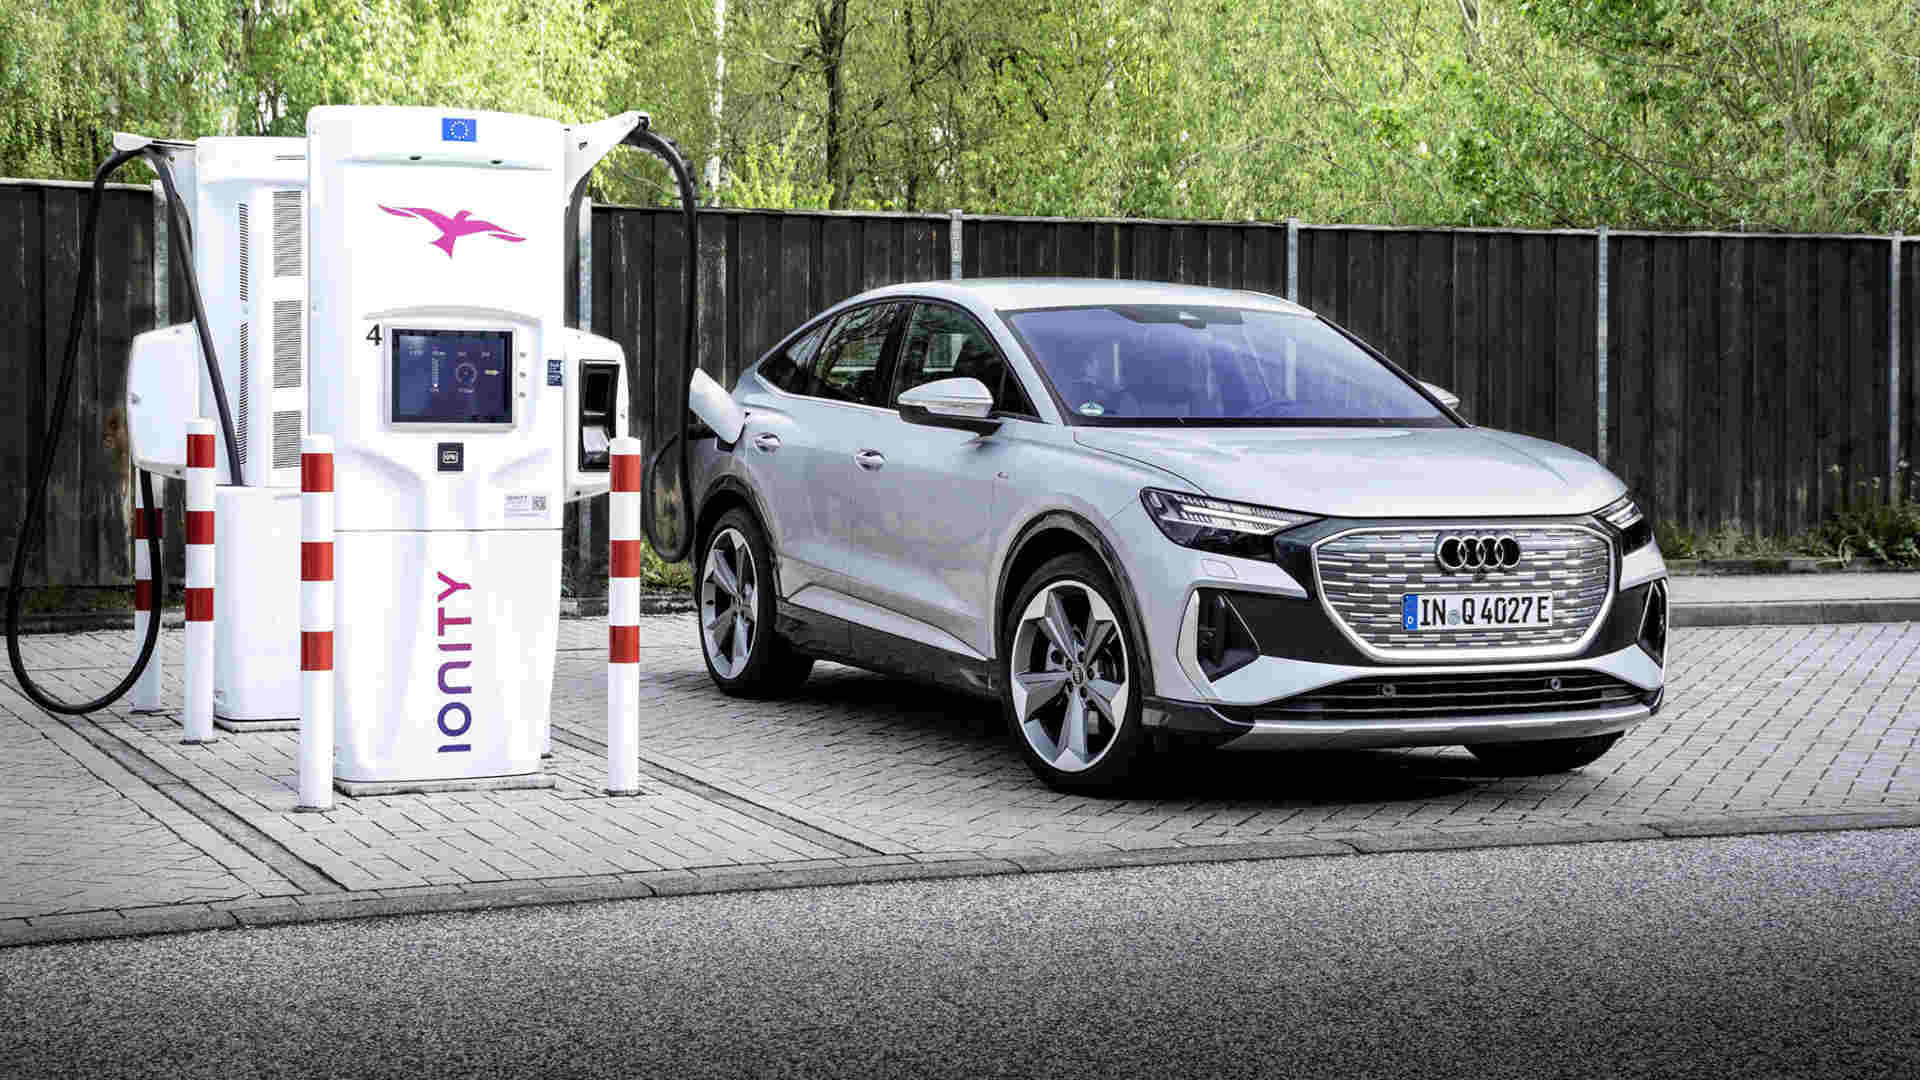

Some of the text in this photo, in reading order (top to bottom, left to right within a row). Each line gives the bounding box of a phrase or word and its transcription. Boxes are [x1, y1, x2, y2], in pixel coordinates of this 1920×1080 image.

[366, 323, 383, 346] 4
[1420, 598, 1446, 626] IN
[1462, 598, 1475, 624] Q
[437, 571, 472, 753] IONITY
